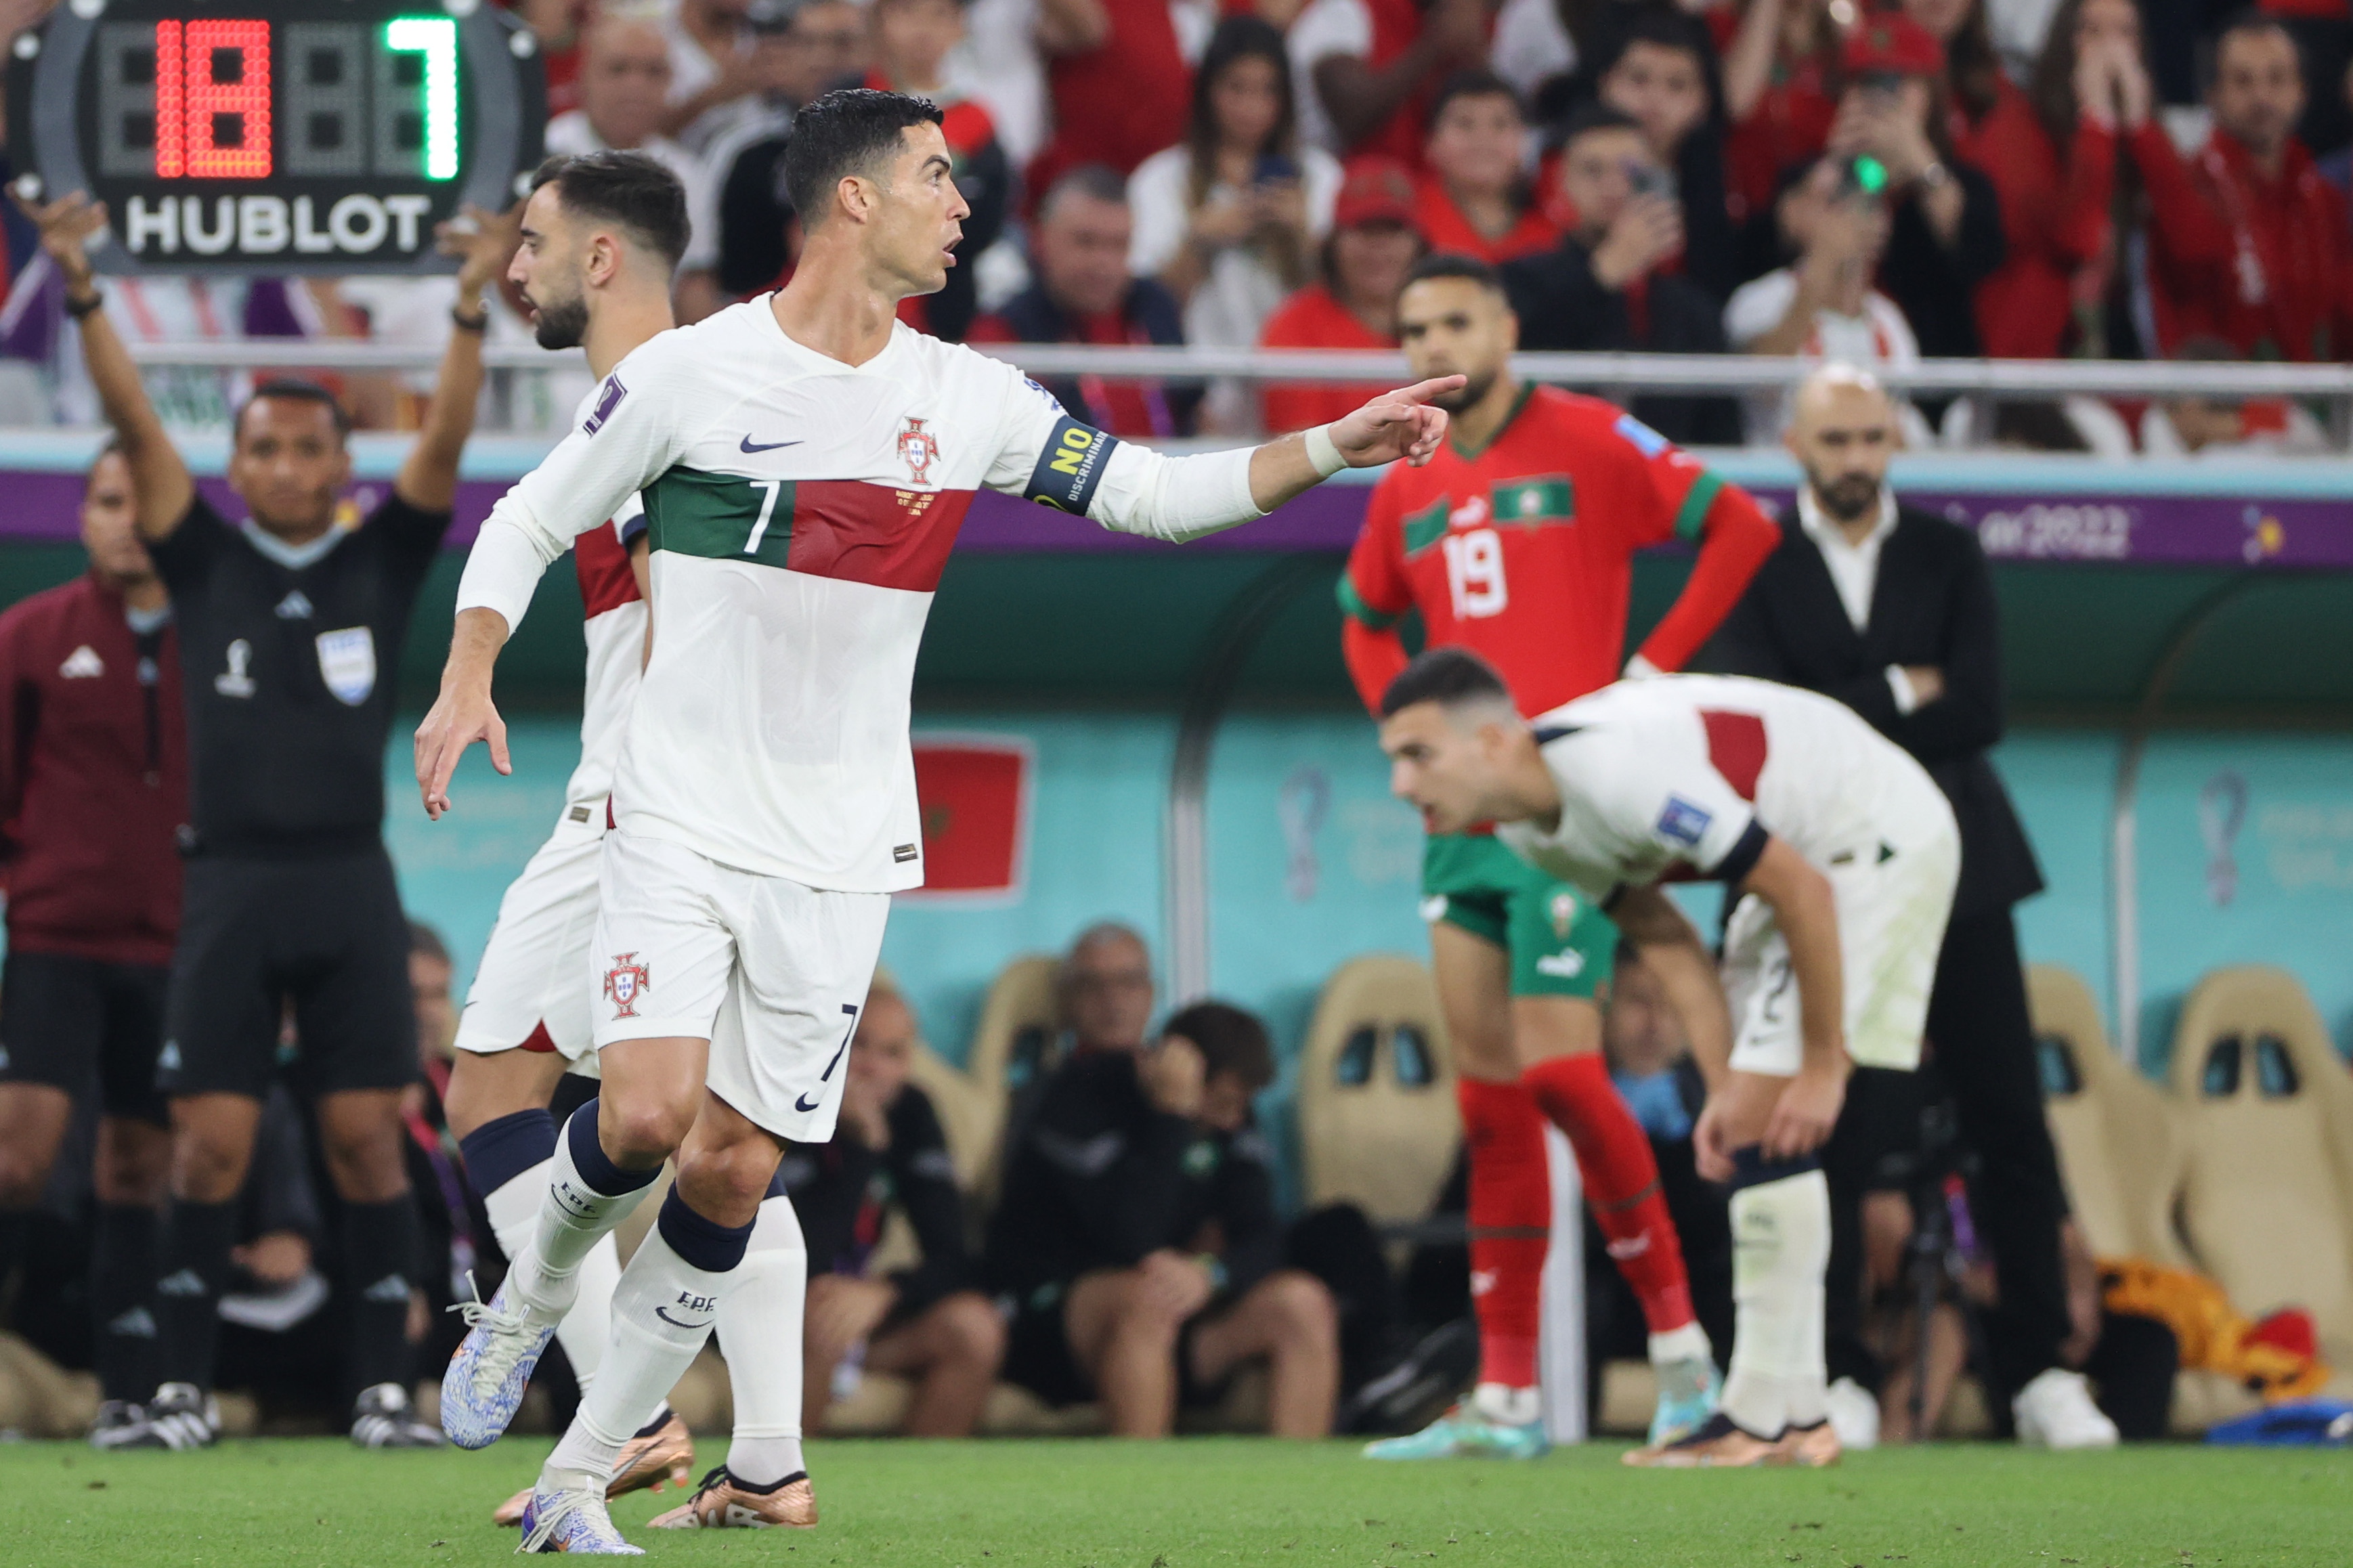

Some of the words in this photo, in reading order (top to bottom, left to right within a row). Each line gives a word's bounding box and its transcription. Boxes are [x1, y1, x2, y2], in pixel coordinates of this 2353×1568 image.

[156, 18, 273, 179] 18
[386, 16, 459, 180] 7
[125, 194, 431, 255] HUBLOT
[1050, 427, 1094, 475] NO
[743, 481, 781, 554] 7
[1441, 528, 1509, 621] 19
[821, 1004, 859, 1082] 7
